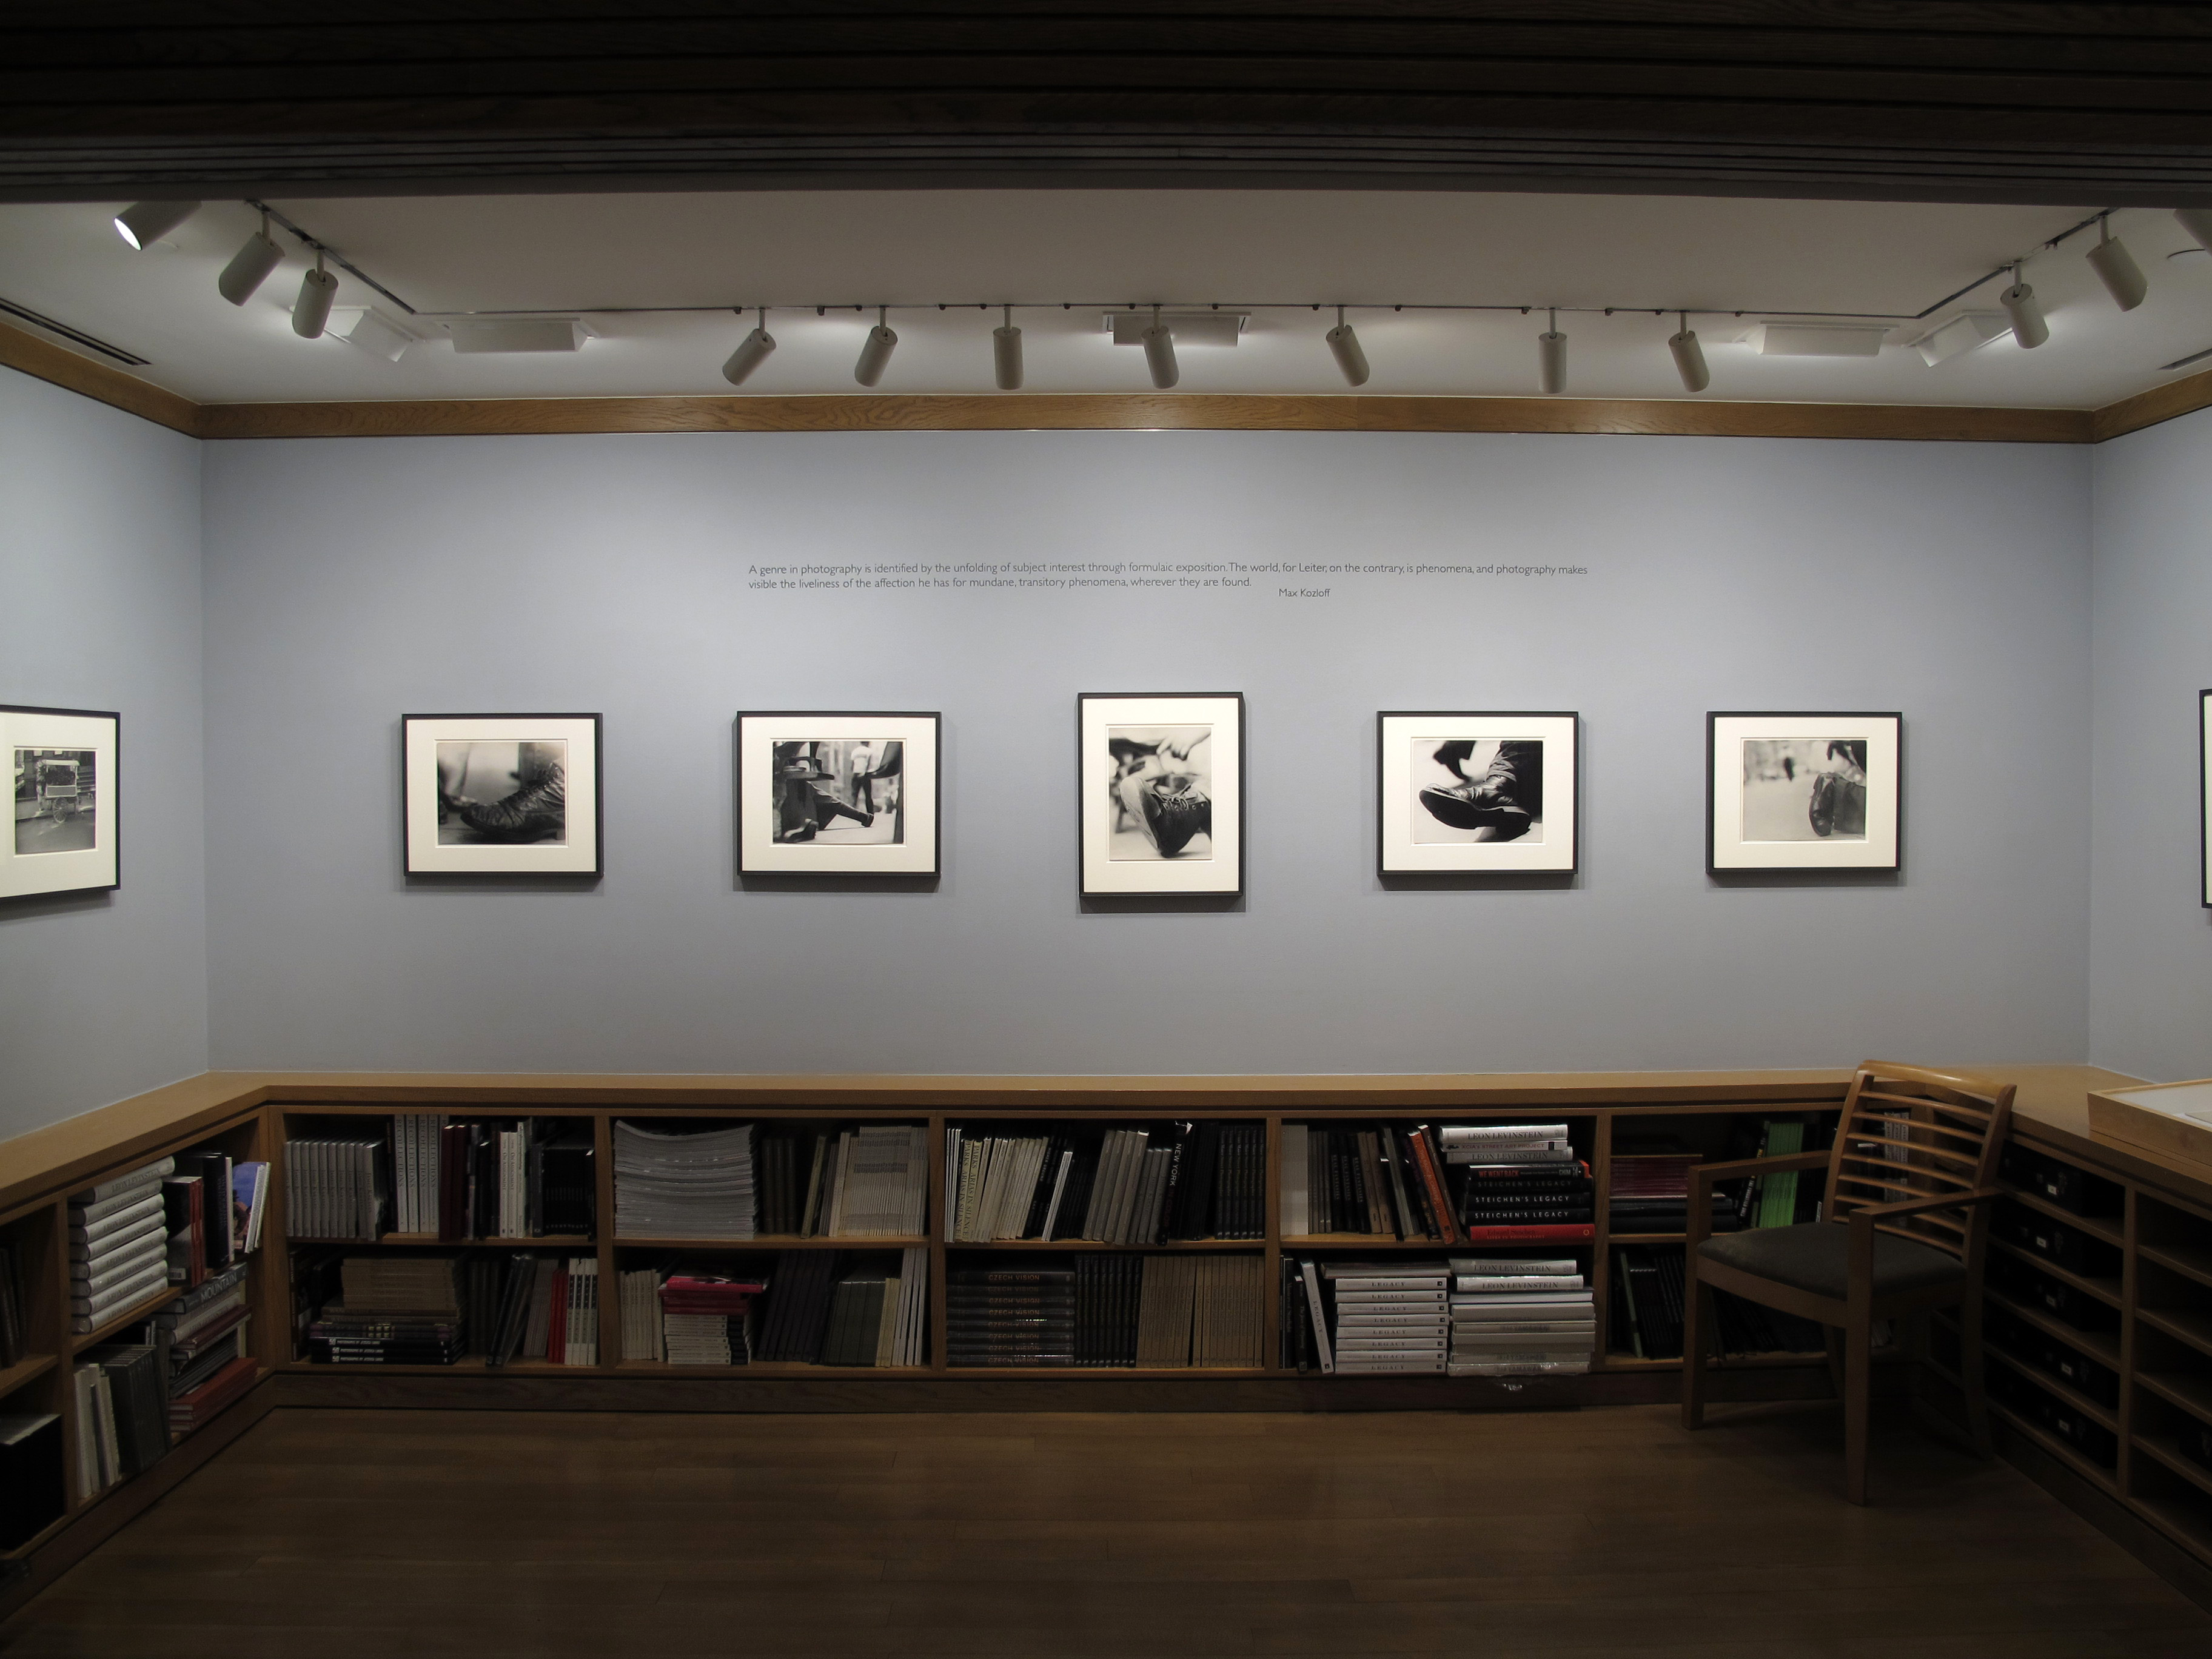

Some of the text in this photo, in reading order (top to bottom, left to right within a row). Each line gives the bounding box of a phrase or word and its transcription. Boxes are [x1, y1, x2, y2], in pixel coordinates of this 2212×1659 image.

[749, 565, 757, 574] A
[760, 567, 787, 577] genre
[790, 565, 798, 574] in
[801, 564, 862, 576] photography
[865, 564, 871, 573] is
[874, 563, 917, 572] identified
[921, 563, 933, 575] by
[934, 563, 951, 572] the
[954, 563, 997, 575] unfolding
[1000, 562, 1011, 572] of
[1013, 563, 1047, 574] subject
[1050, 563, 1085, 572] interest
[1088, 562, 1125, 574] through
[1129, 562, 1173, 571] formulaic
[1250, 563, 1280, 573] world,
[1282, 563, 1296, 572] for
[1299, 563, 1327, 573] Leiter,
[1344, 563, 1360, 572] the
[1363, 565, 1404, 575] contrary,
[1407, 563, 1413, 572] is
[1416, 563, 1474, 575] phenomena,
[1476, 564, 1493, 573] and
[1496, 564, 1556, 576] photography
[1558, 565, 1587, 574] makes
[749, 579, 777, 589] visible
[780, 579, 796, 588] the
[799, 578, 839, 588] liveliness
[843, 578, 854, 588] of
[856, 578, 871, 588] the
[875, 578, 915, 588] affection
[919, 578, 930, 587] he
[934, 577, 950, 587] has
[953, 577, 967, 587] for
[970, 577, 1016, 587] mundane,
[1019, 577, 1066, 589] transitory
[1069, 577, 1128, 589] phenomena,
[1130, 577, 1177, 586] wherever
[1179, 577, 1201, 589] they
[1222, 577, 1252, 586] found.
[1279, 588, 1330, 597] Max Kozloff
[1491, 1131, 1543, 1139] LEVINSTEIN
[963, 1143, 971, 1166] PARKS
[972, 1145, 981, 1169] PARKS
[968, 1173, 977, 1194] ARIAS
[1164, 1143, 1182, 1227] NEW YORK IN COLOR
[958, 1193, 965, 1202] IN
[954, 1203, 964, 1233] SILENCE
[962, 1205, 972, 1235] SILENCE
[200, 1273, 238, 1301] MOUNTAIN
[1313, 1301, 1323, 1333] LEGACY
